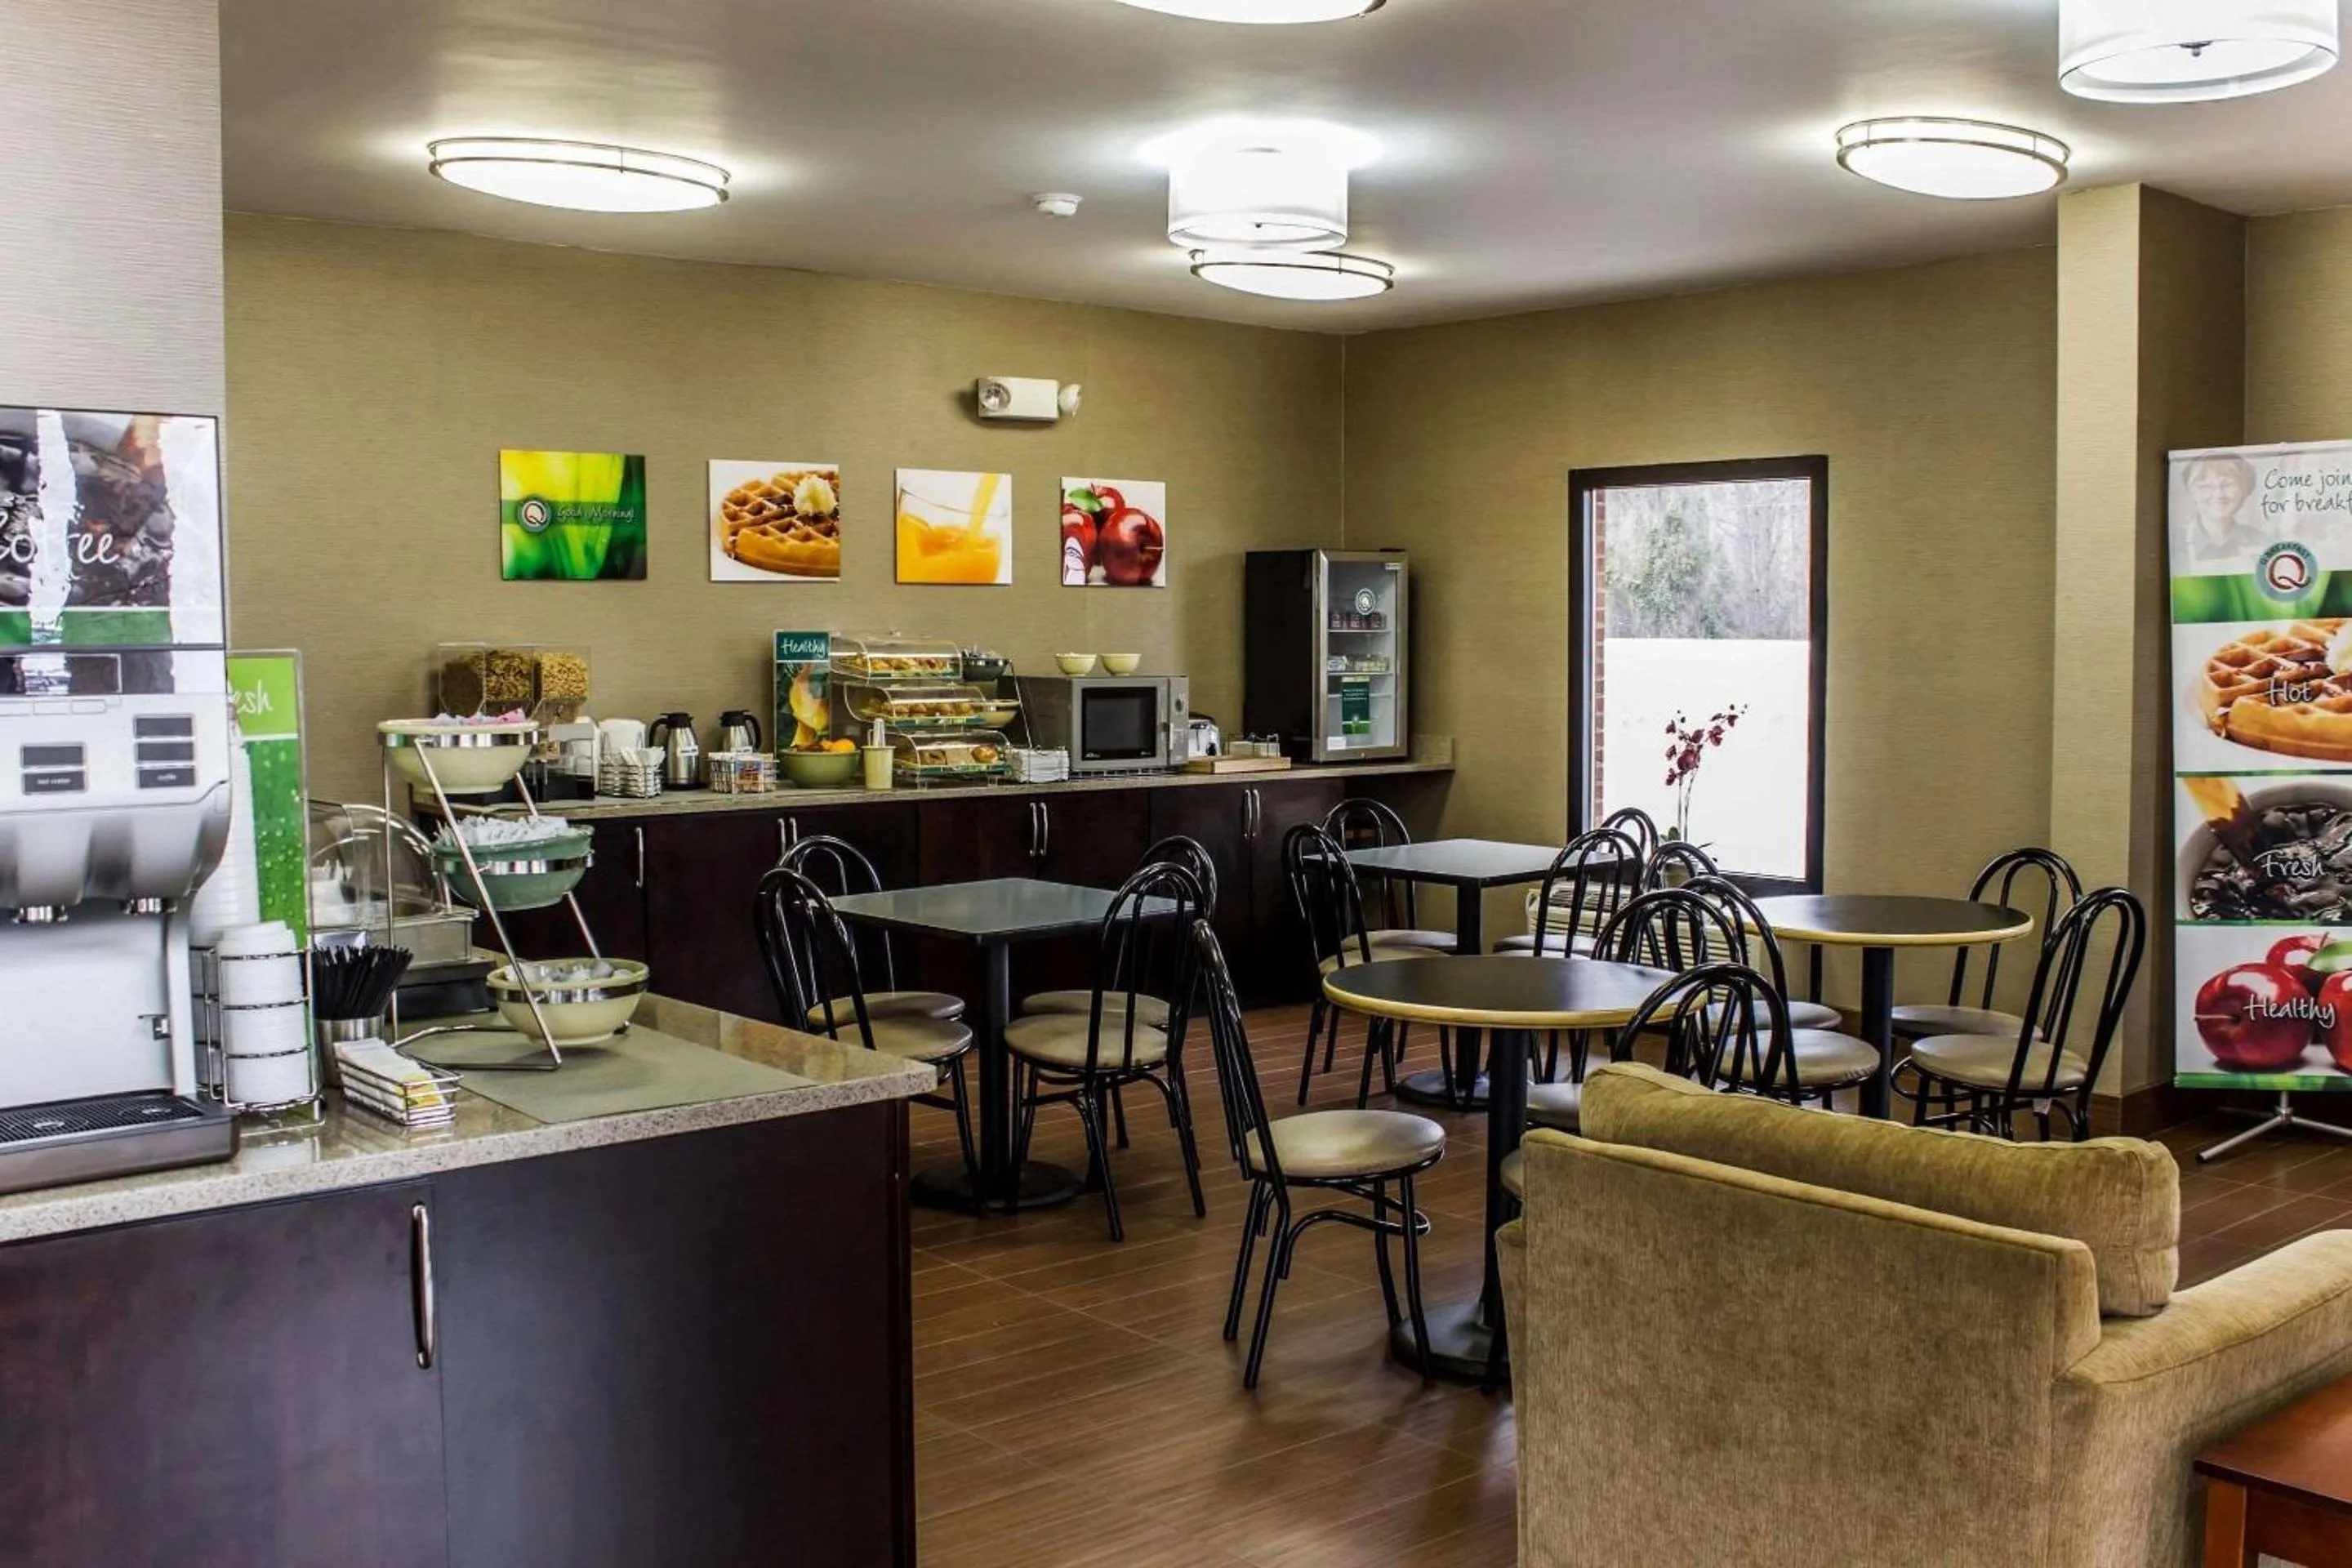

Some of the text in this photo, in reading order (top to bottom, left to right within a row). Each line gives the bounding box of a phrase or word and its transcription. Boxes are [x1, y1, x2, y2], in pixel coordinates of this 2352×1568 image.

[2264, 468, 2352, 496] Come join
[2261, 492, 2290, 520] for
[2269, 554, 2312, 590] Q
[780, 638, 825, 659] Healthy
[2264, 677, 2312, 706] Hot
[2252, 849, 2326, 878] Fresh
[2243, 993, 2336, 1029] Healthy
